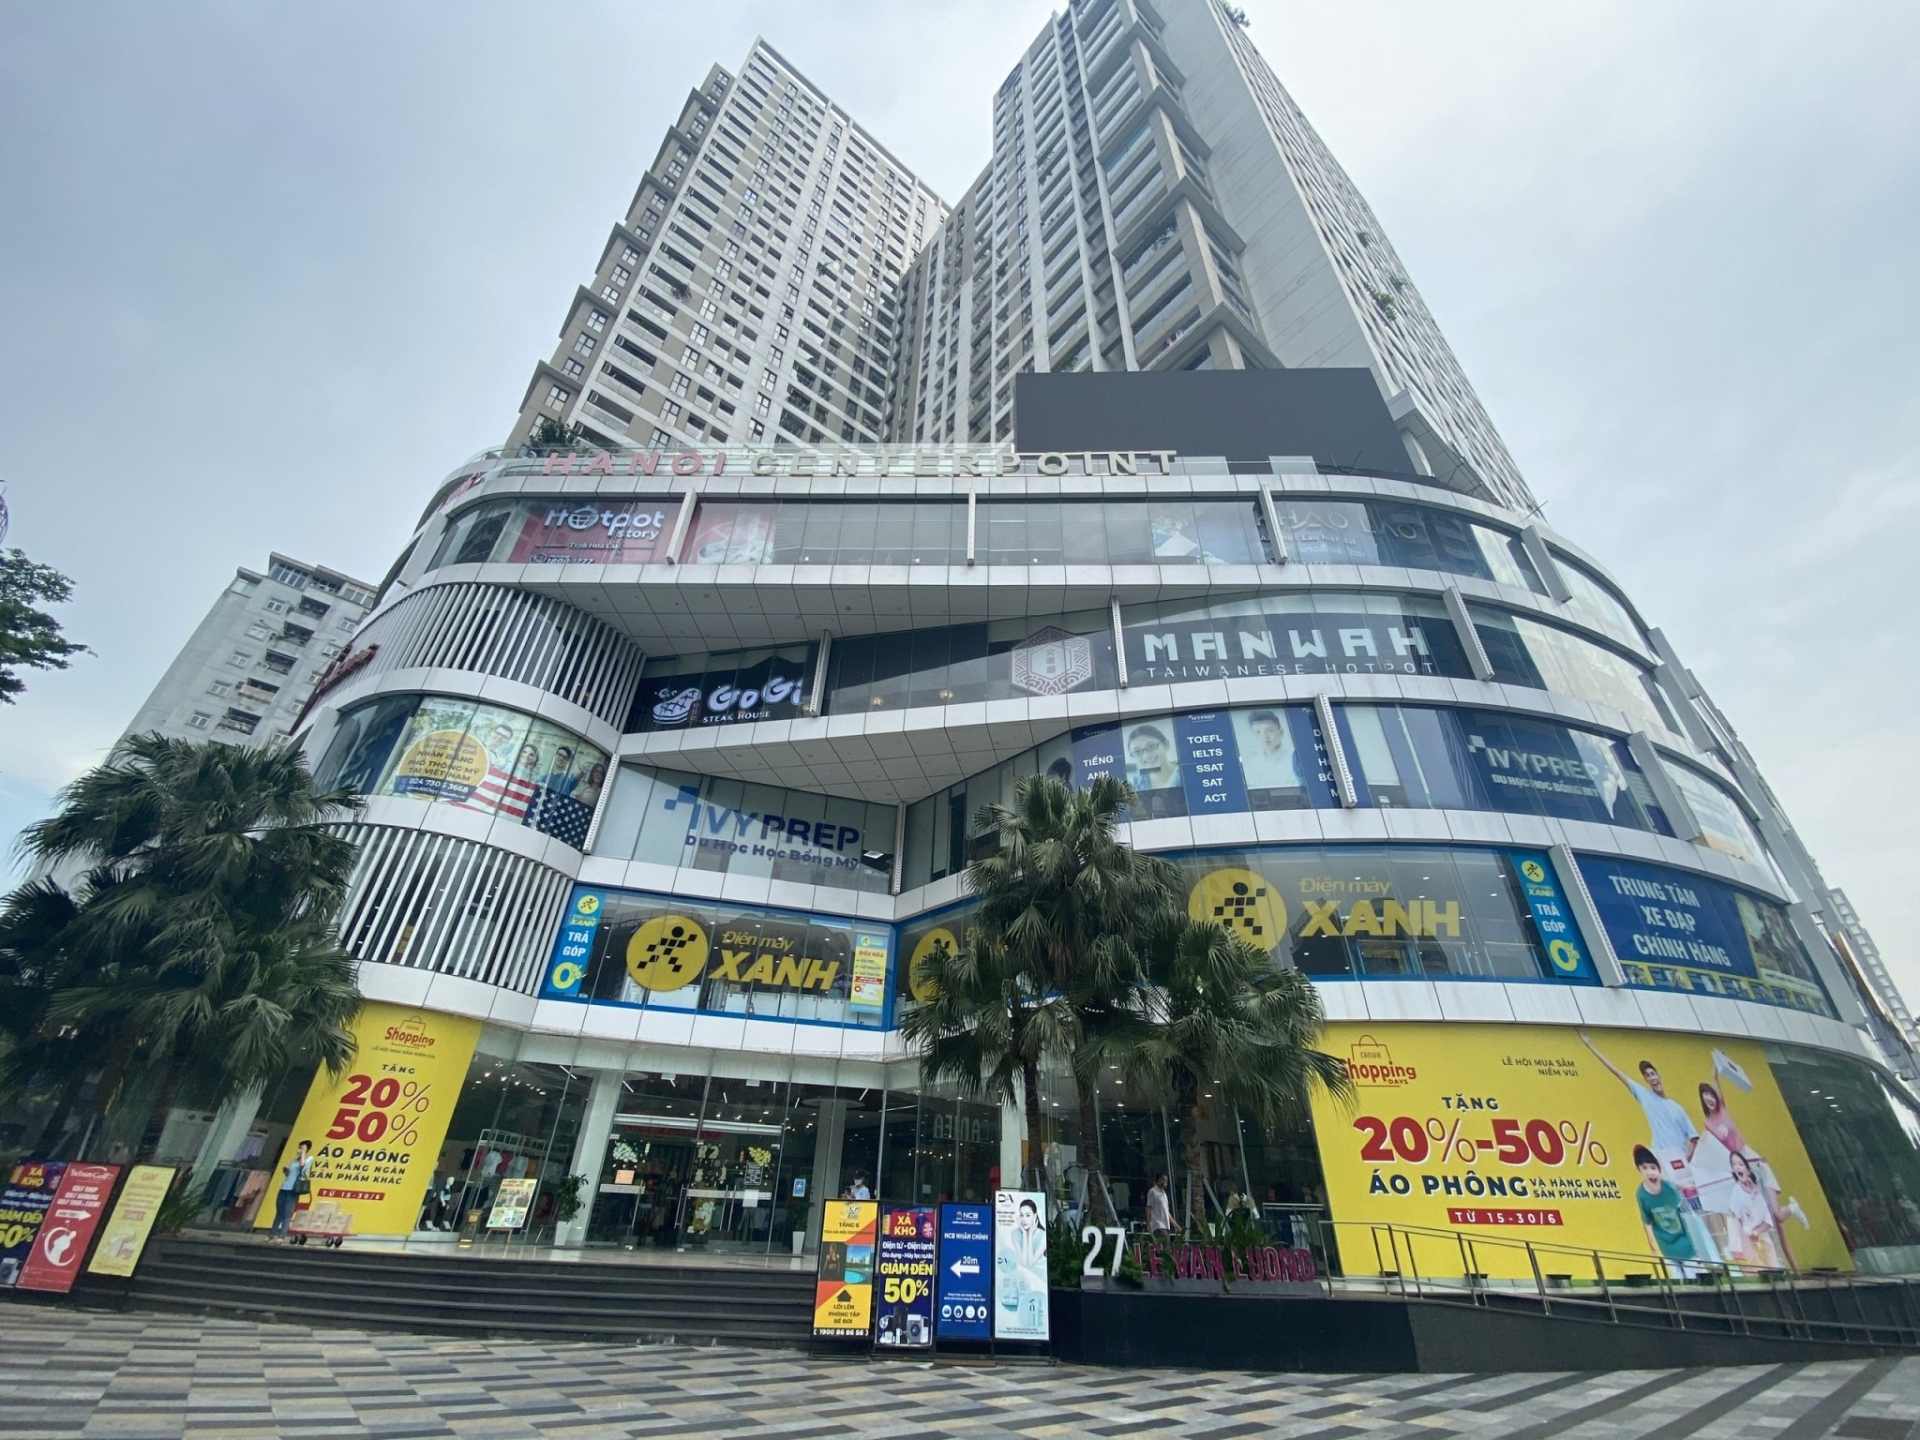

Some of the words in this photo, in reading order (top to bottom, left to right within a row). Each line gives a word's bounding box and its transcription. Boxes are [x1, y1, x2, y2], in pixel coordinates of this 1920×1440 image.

[542, 452, 726, 476] HANOI
[750, 450, 1177, 477] CENTERPOINT
[616, 529, 659, 541] story
[1143, 626, 1430, 662] MANWAH
[1146, 664, 1305, 678] TAIWANESE
[1325, 662, 1434, 675] HOTPOT
[703, 714, 733, 724] STEAK
[737, 711, 771, 720] HOUSE
[1187, 734, 1223, 745] TOEFL
[1192, 748, 1223, 758] IELTS
[1083, 754, 1114, 768] TIẾNG
[1196, 763, 1224, 773] SSAT
[1202, 778, 1223, 787] SAT
[1204, 793, 1227, 803] ACT
[685, 835, 710, 847] Du
[713, 838, 748, 855] Học
[752, 844, 786, 860] Học
[789, 848, 833, 867] Bổng
[835, 856, 859, 871] Mỹ
[1298, 876, 1345, 896] Điện
[1349, 876, 1392, 896] máy
[1528, 888, 1555, 897] XANH
[1608, 875, 1665, 900] TRUNG
[1665, 882, 1701, 908] TÂM
[1535, 901, 1560, 916] TRẢ
[1298, 899, 1460, 937] XANH
[1640, 904, 1665, 927] XE
[1665, 910, 1697, 935] ĐẠP
[1541, 919, 1566, 933] GÓP
[568, 930, 589, 943] TRẢ
[722, 930, 757, 948] Điện
[759, 935, 794, 952] máy
[562, 945, 587, 957] GÓP
[1549, 939, 1581, 972] 0%
[1632, 930, 1689, 961] CHÍNH
[1687, 939, 1732, 967] HÃNG
[552, 961, 582, 989] 0%
[707, 949, 840, 990] XANH
[384, 1026, 435, 1046] Shopping
[381, 1063, 415, 1075] TẶNG
[1502, 1056, 1514, 1066] LỄ
[1515, 1058, 1532, 1067] HỘI
[1534, 1059, 1555, 1067] MUA
[1555, 1057, 1575, 1067] SẮM
[1339, 1058, 1417, 1083] hopping
[1538, 1067, 1561, 1076] NIỀM
[339, 1074, 432, 1113] 20%
[1441, 1093, 1499, 1113] TẶNG
[325, 1108, 421, 1146] 50%
[1353, 1115, 1609, 1166] 20%-50%
[317, 1143, 345, 1158] ÁO
[350, 1148, 411, 1165] PHÔNG
[28, 1164, 44, 1176] XẢ
[314, 1160, 330, 1169] VÀ
[335, 1161, 370, 1172] HÀNG
[373, 1165, 406, 1175] NGÀN
[21, 1177, 45, 1187] KHO
[309, 1170, 333, 1180] SẢN
[336, 1172, 370, 1182] PHẨM
[373, 1174, 403, 1185] KHÁC
[1369, 1168, 1411, 1195] ÁO
[1421, 1169, 1529, 1197] PHÔNG
[1529, 1176, 1546, 1188] VÀ
[1550, 1176, 1583, 1188] HÀNG
[1587, 1177, 1618, 1189] NGÀN
[321, 1189, 336, 1197] TỪ
[341, 1192, 381, 1200] 15-30/6
[1533, 1187, 1556, 1198] SẢN
[1558, 1187, 1590, 1199] PHẨM
[1592, 1187, 1622, 1199] KHÁC
[897, 1213, 912, 1226] XẢ
[1454, 1209, 1477, 1223] TỪ
[1486, 1212, 1557, 1225] 15-30/6
[894, 1227, 916, 1236] KHO
[972, 1232, 989, 1240] CHÍNH
[882, 1241, 895, 1250] Điện
[907, 1241, 921, 1251] Điện
[921, 1242, 934, 1251] lạnh
[1081, 1225, 1126, 1278] 27
[880, 1260, 909, 1275] GIẢM
[910, 1260, 933, 1275] ĐẾN
[962, 1256, 979, 1265] 30m
[884, 1277, 929, 1304] 50%
